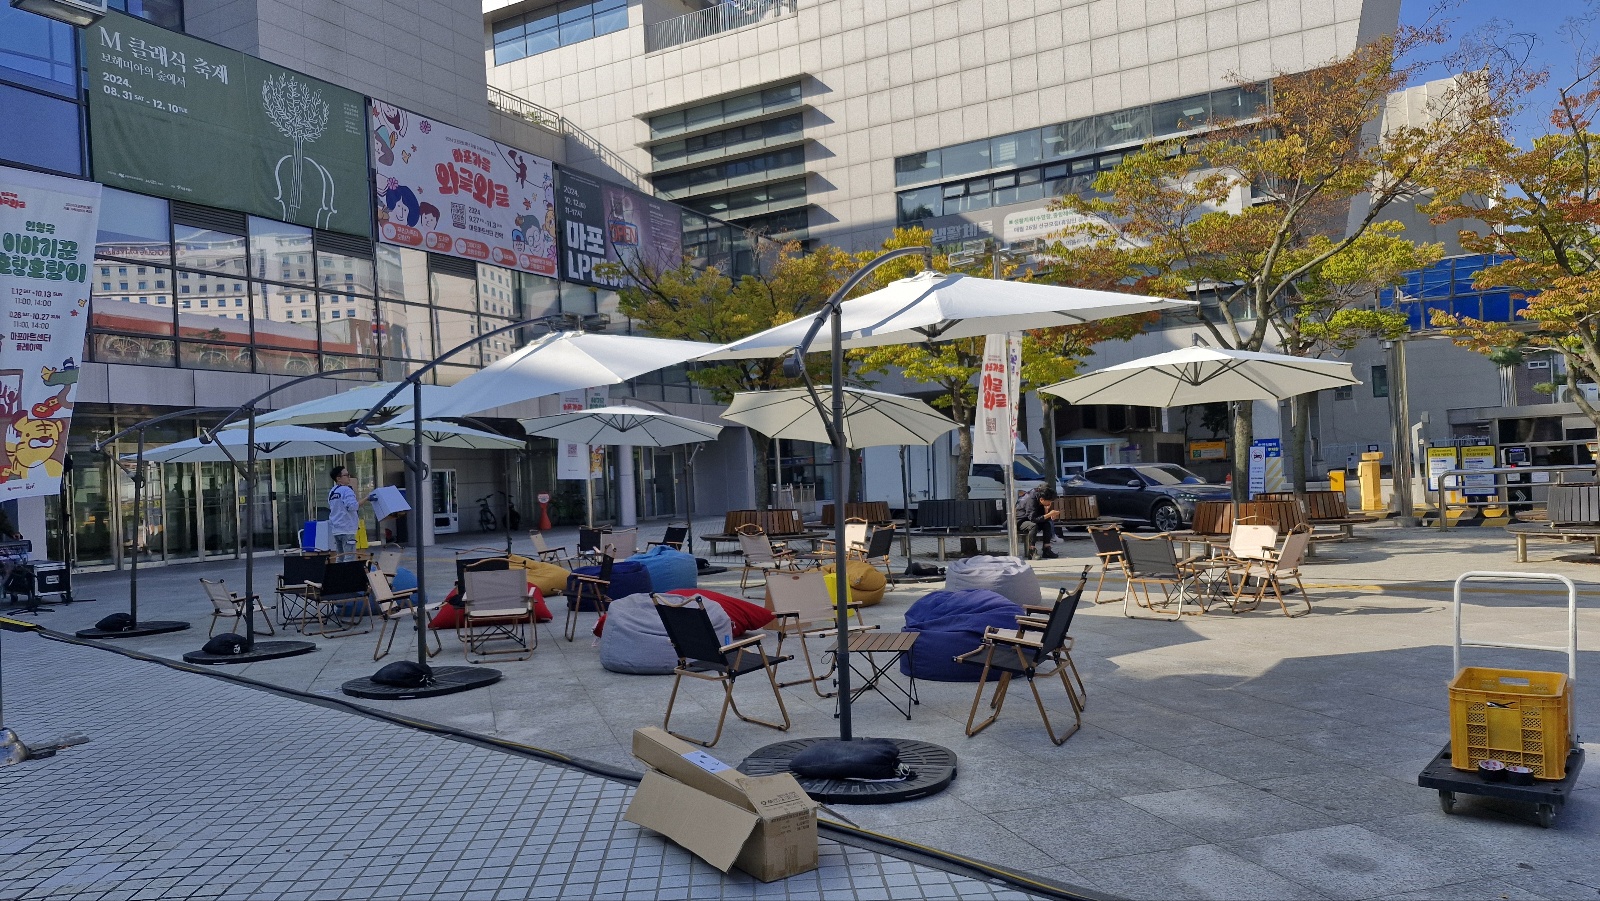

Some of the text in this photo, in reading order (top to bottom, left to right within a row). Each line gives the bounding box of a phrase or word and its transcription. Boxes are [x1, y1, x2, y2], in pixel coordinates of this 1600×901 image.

[99, 26, 228, 85] M 클래식 축제
[101, 52, 186, 88] 보헤미아의 숲에서
[103, 72, 132, 88] 2024.
[452, 148, 491, 173] 마포가을
[434, 162, 510, 208] 와글와글
[26, 220, 55, 234] 인형극
[566, 220, 604, 255] 마포
[3, 232, 78, 260] 이야기꾼
[11, 332, 51, 342] 마포아트센터
